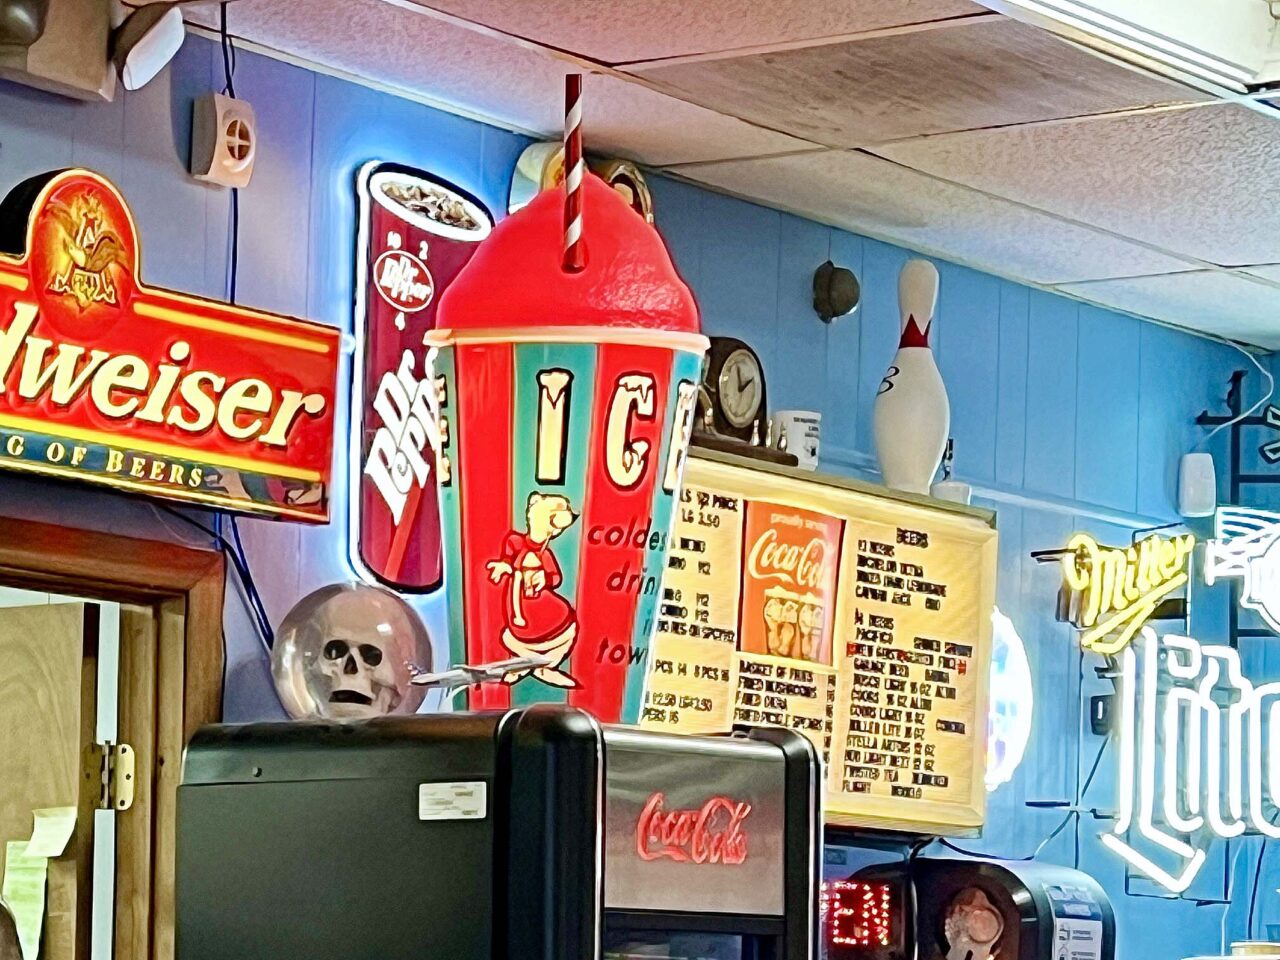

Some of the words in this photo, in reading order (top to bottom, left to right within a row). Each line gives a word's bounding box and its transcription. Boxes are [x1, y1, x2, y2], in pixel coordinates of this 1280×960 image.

[106, 450, 206, 488] BEERS
[1065, 533, 1196, 627] Miller
[636, 791, 752, 865] Coca-Cola
